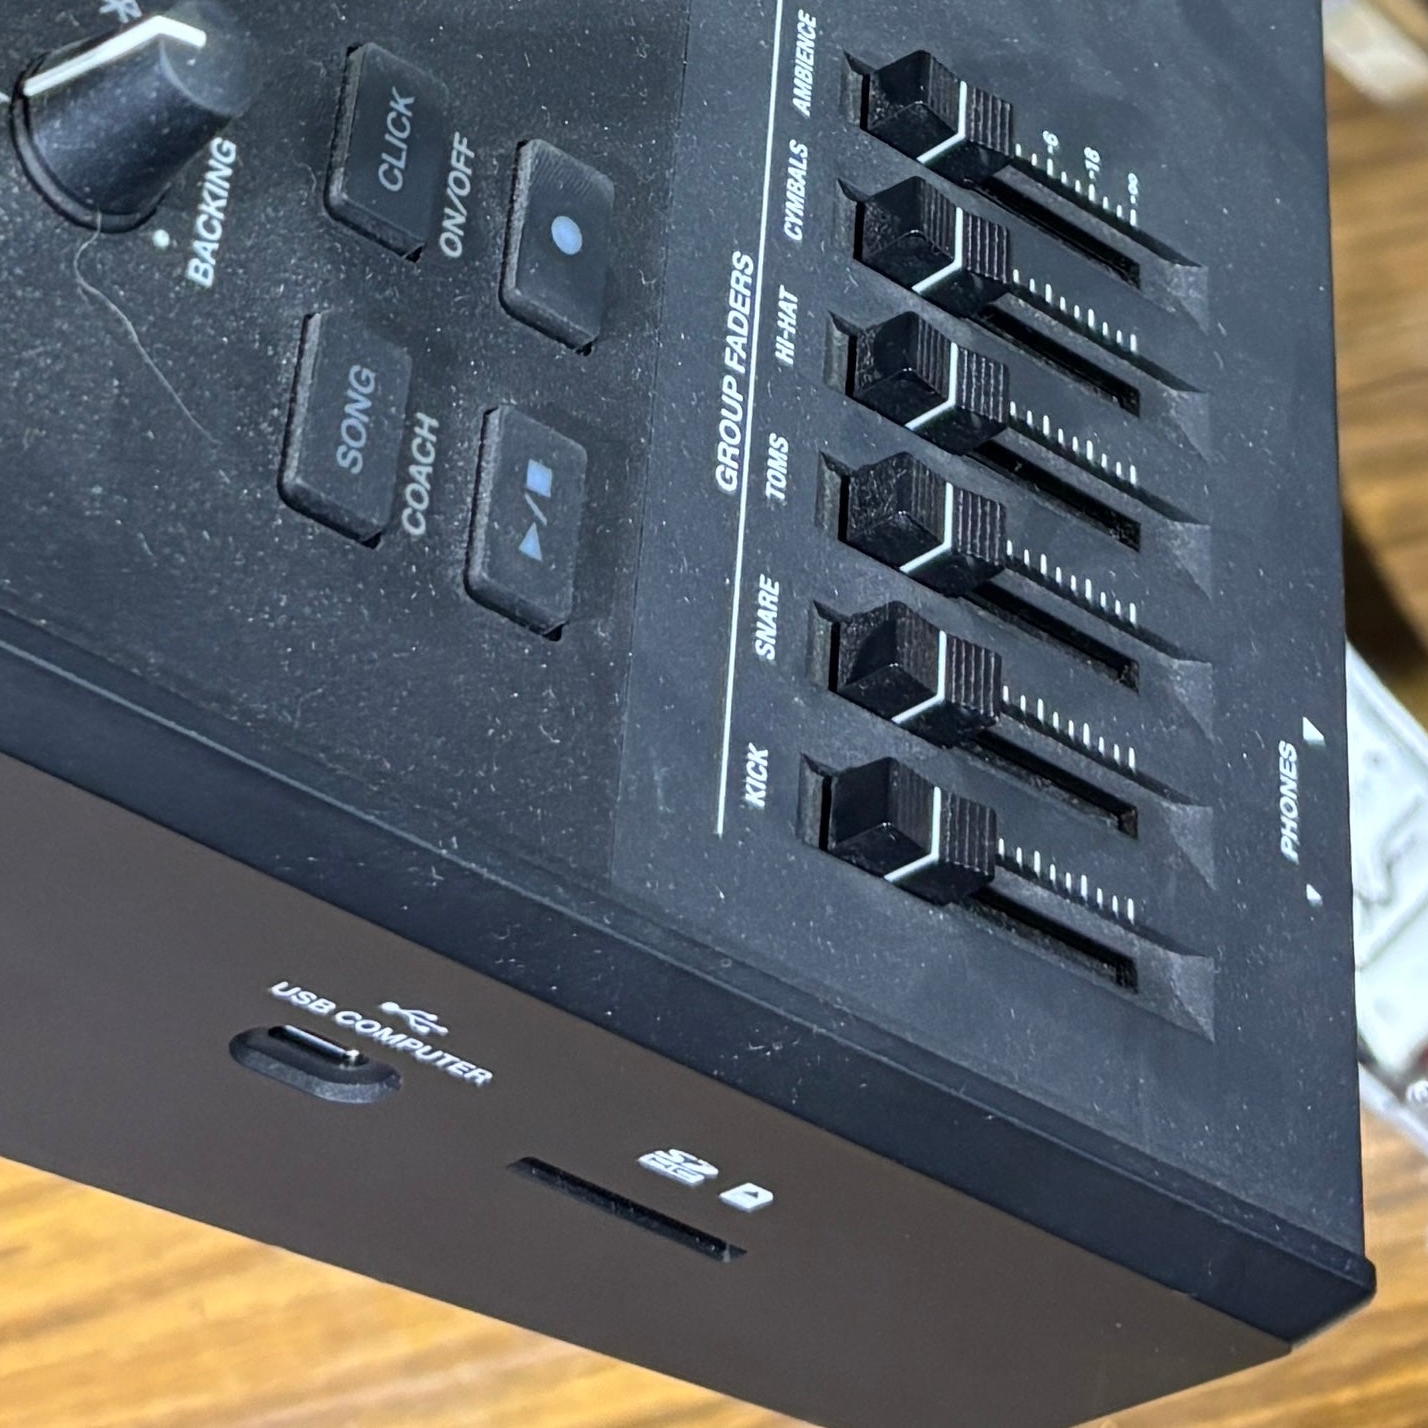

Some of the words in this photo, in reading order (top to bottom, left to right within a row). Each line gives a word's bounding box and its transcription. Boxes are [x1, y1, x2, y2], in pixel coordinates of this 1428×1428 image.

[790, 10, 817, 118] AMBIENCE
[378, 87, 418, 193] CLICK
[784, 139, 808, 242] CYMBALS
[185, 136, 237, 289] BACKING
[439, 131, 477, 259] ON/OFF
[724, 250, 754, 374] FADERS
[775, 284, 800, 366] HI-HAT
[336, 364, 377, 476] SONG
[716, 374, 748, 494] GROUP
[765, 434, 789, 502] TOMS
[400, 412, 440, 539] COACH
[756, 574, 780, 661] SNARE
[747, 743, 769, 809] KICK
[1280, 740, 1298, 862] PHONES
[269, 981, 336, 1017] USB
[334, 1009, 494, 1088] COMPUTER
